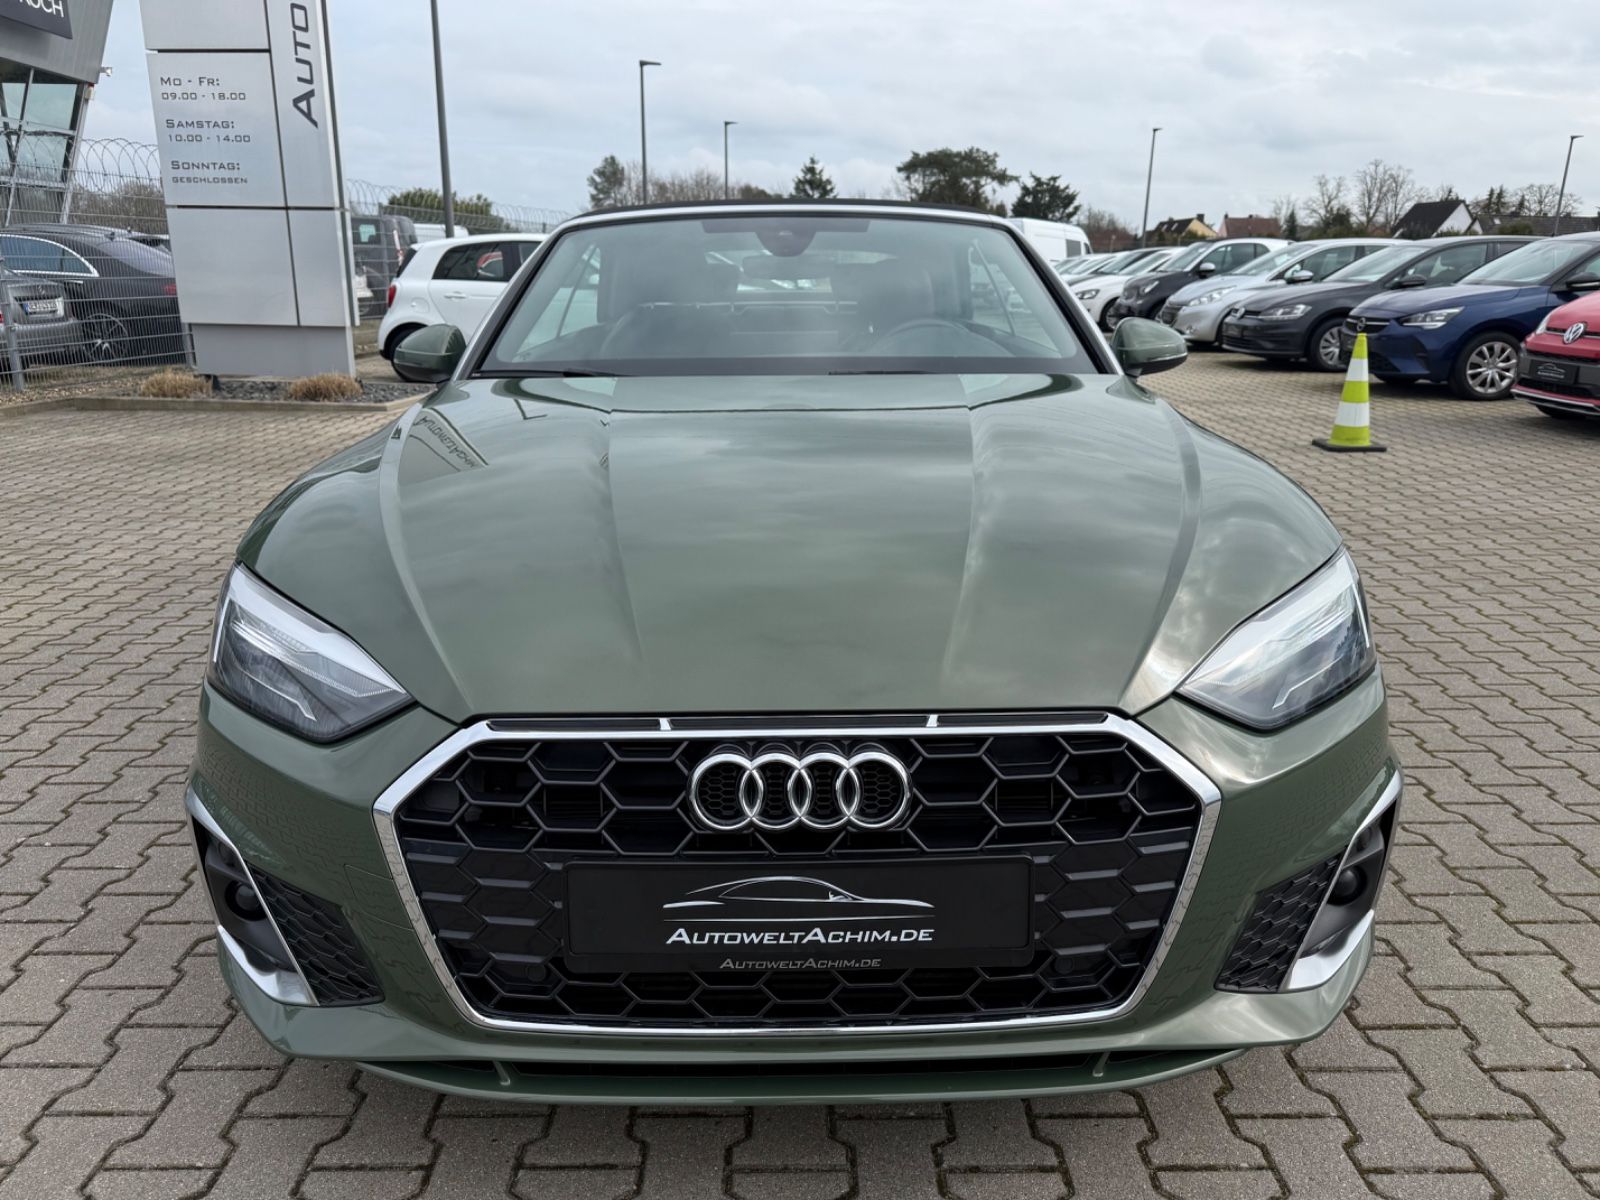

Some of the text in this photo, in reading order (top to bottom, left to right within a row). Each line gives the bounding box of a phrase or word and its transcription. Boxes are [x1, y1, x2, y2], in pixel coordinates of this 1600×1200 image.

[19, 0, 65, 18] OCH
[290, 2, 319, 129] AUTO
[160, 76, 182, 87] MO
[198, 76, 220, 87] FR:
[161, 92, 198, 101] 09.00
[211, 92, 246, 101] 18.00
[165, 119, 235, 129] SAMSTAG:
[168, 134, 203, 143] 10.00
[216, 134, 251, 143] 14.00
[171, 160, 241, 171] SONNTAG:
[172, 176, 249, 185] GESCHLOSSEN
[665, 927, 935, 945] AUTOWELTACHIM.DE
[719, 957, 882, 970] AUTOWELTACHIM.DE
